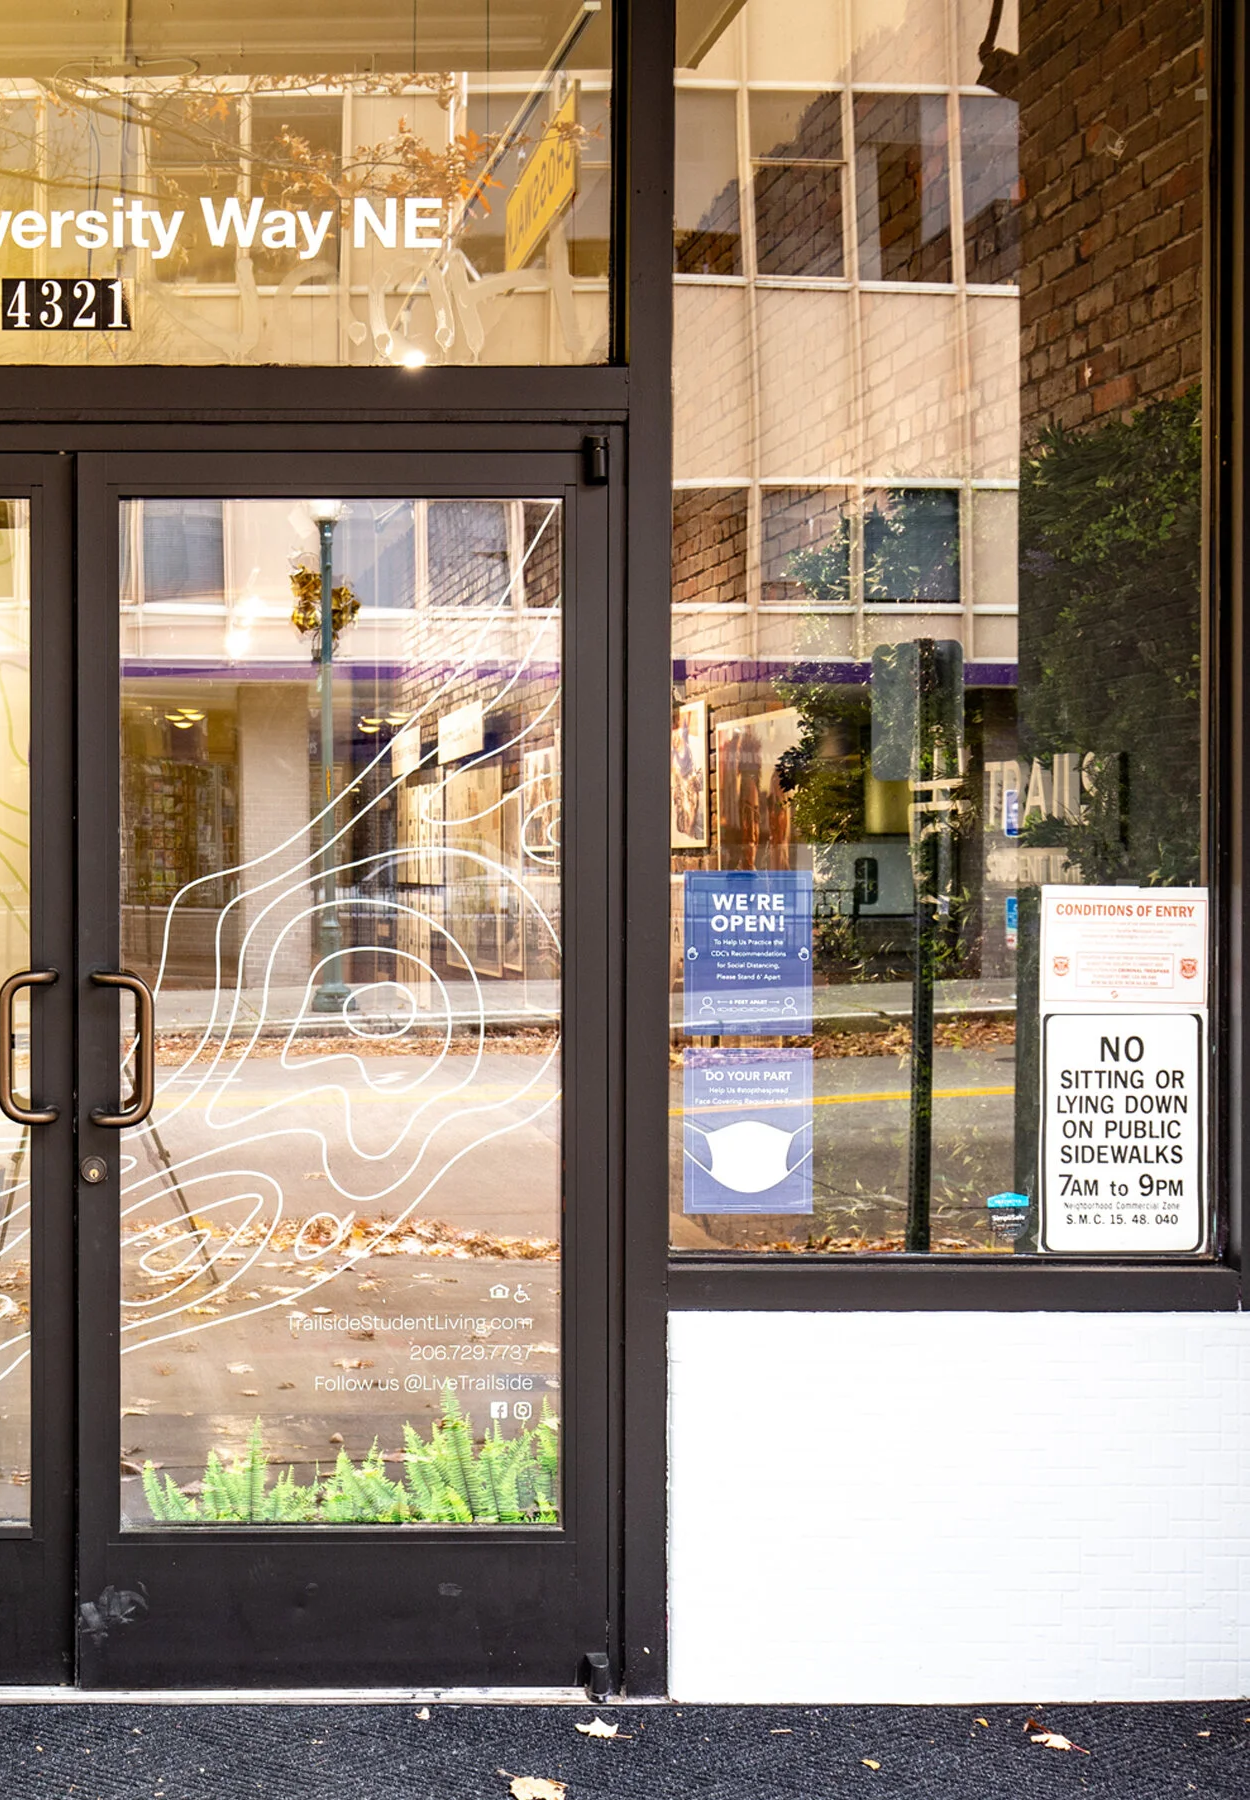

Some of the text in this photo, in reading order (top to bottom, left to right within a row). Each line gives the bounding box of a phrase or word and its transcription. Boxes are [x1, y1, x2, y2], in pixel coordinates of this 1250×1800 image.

[199, 198, 332, 259] Way
[354, 197, 442, 249] NE
[5, 279, 128, 331] 4321
[712, 893, 785, 911] WE'RE
[1056, 903, 1195, 918] CONDITIONS OF ENTRY
[711, 915, 785, 932] OPEN!
[723, 939, 737, 947] Help
[764, 973, 782, 982] Apart
[1100, 1036, 1145, 1063] NO
[705, 1071, 793, 1081] DO YOUR PART
[1060, 1069, 1185, 1090] SITTING OR
[709, 1087, 726, 1095] Help
[1056, 1095, 1188, 1114] LYING DOWN
[1062, 1120, 1182, 1139] ON PUBLIC
[1060, 1145, 1184, 1164] SIDEWALKS
[1058, 1173, 1184, 1197] 7AM to 9PM
[1063, 1201, 1181, 1211] Neighborhood Commercial Zone
[286, 1315, 533, 1334] TrailsideStudentLiving.com
[409, 1344, 532, 1361] 206.729.7737
[314, 1374, 533, 1393] Follow us @LiveTrailside
